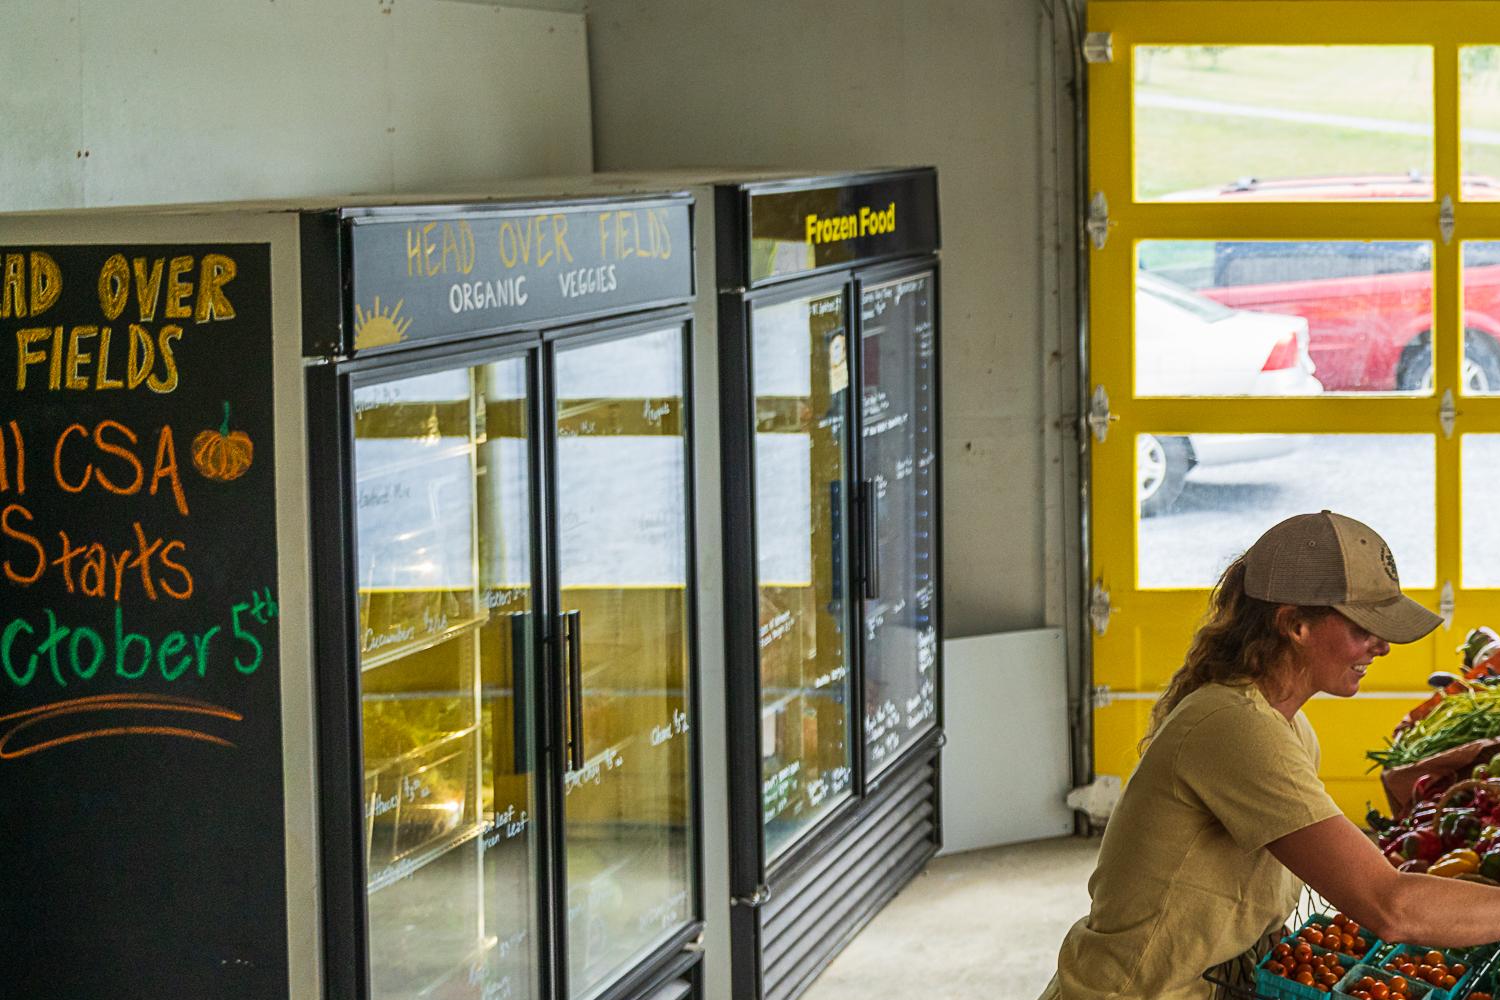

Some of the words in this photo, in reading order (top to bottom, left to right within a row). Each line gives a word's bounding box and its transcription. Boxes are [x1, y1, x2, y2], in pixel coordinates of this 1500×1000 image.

[407, 220, 476, 277] HEAD
[499, 211, 574, 268] OVER
[599, 207, 673, 261] FIELDS
[805, 213, 858, 246] Frozen
[859, 202, 897, 238] Food
[0, 251, 62, 319] AD
[98, 252, 237, 324] OVER
[449, 275, 528, 314] ORGANIC
[559, 264, 618, 299] VEGGIES
[16, 324, 184, 394] FIELDS
[53, 419, 189, 517] CSA
[1, 504, 194, 601] Starts
